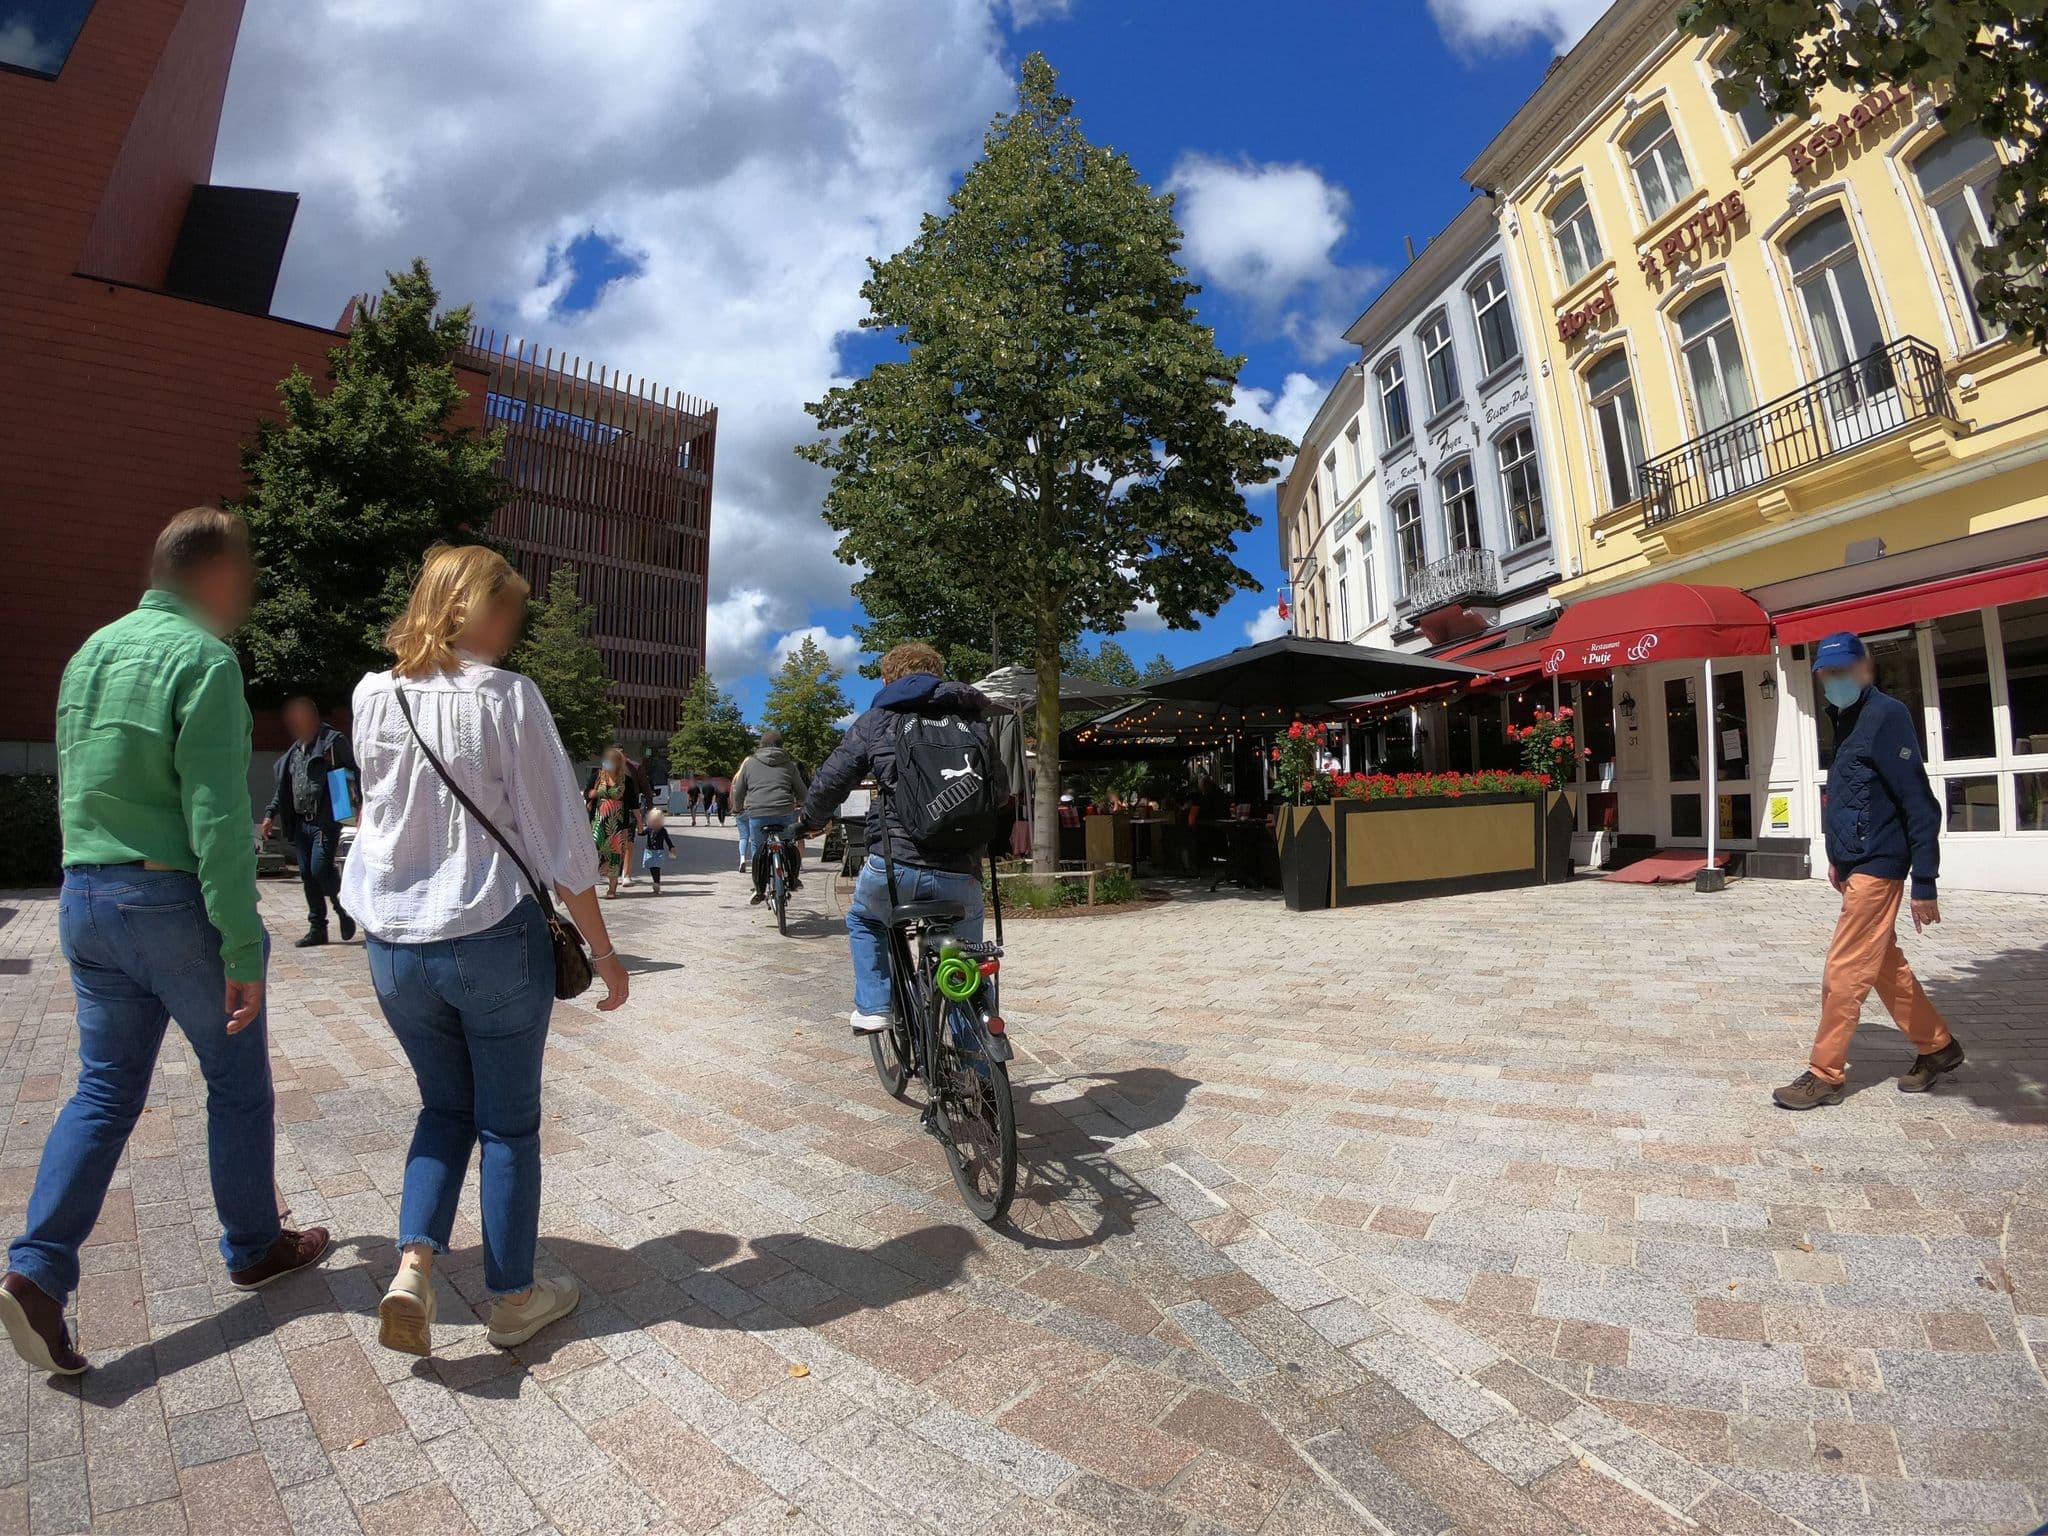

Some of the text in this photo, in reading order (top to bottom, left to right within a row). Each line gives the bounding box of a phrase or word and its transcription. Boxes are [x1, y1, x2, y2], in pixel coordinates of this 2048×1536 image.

[1557, 281, 1614, 344] Hotel
[1436, 428, 1462, 460] Foyer
[1588, 651, 1612, 665] Putje
[1591, 641, 1620, 652] Restaurant
[1628, 736, 1638, 746] 31
[926, 774, 979, 821] PUMA
